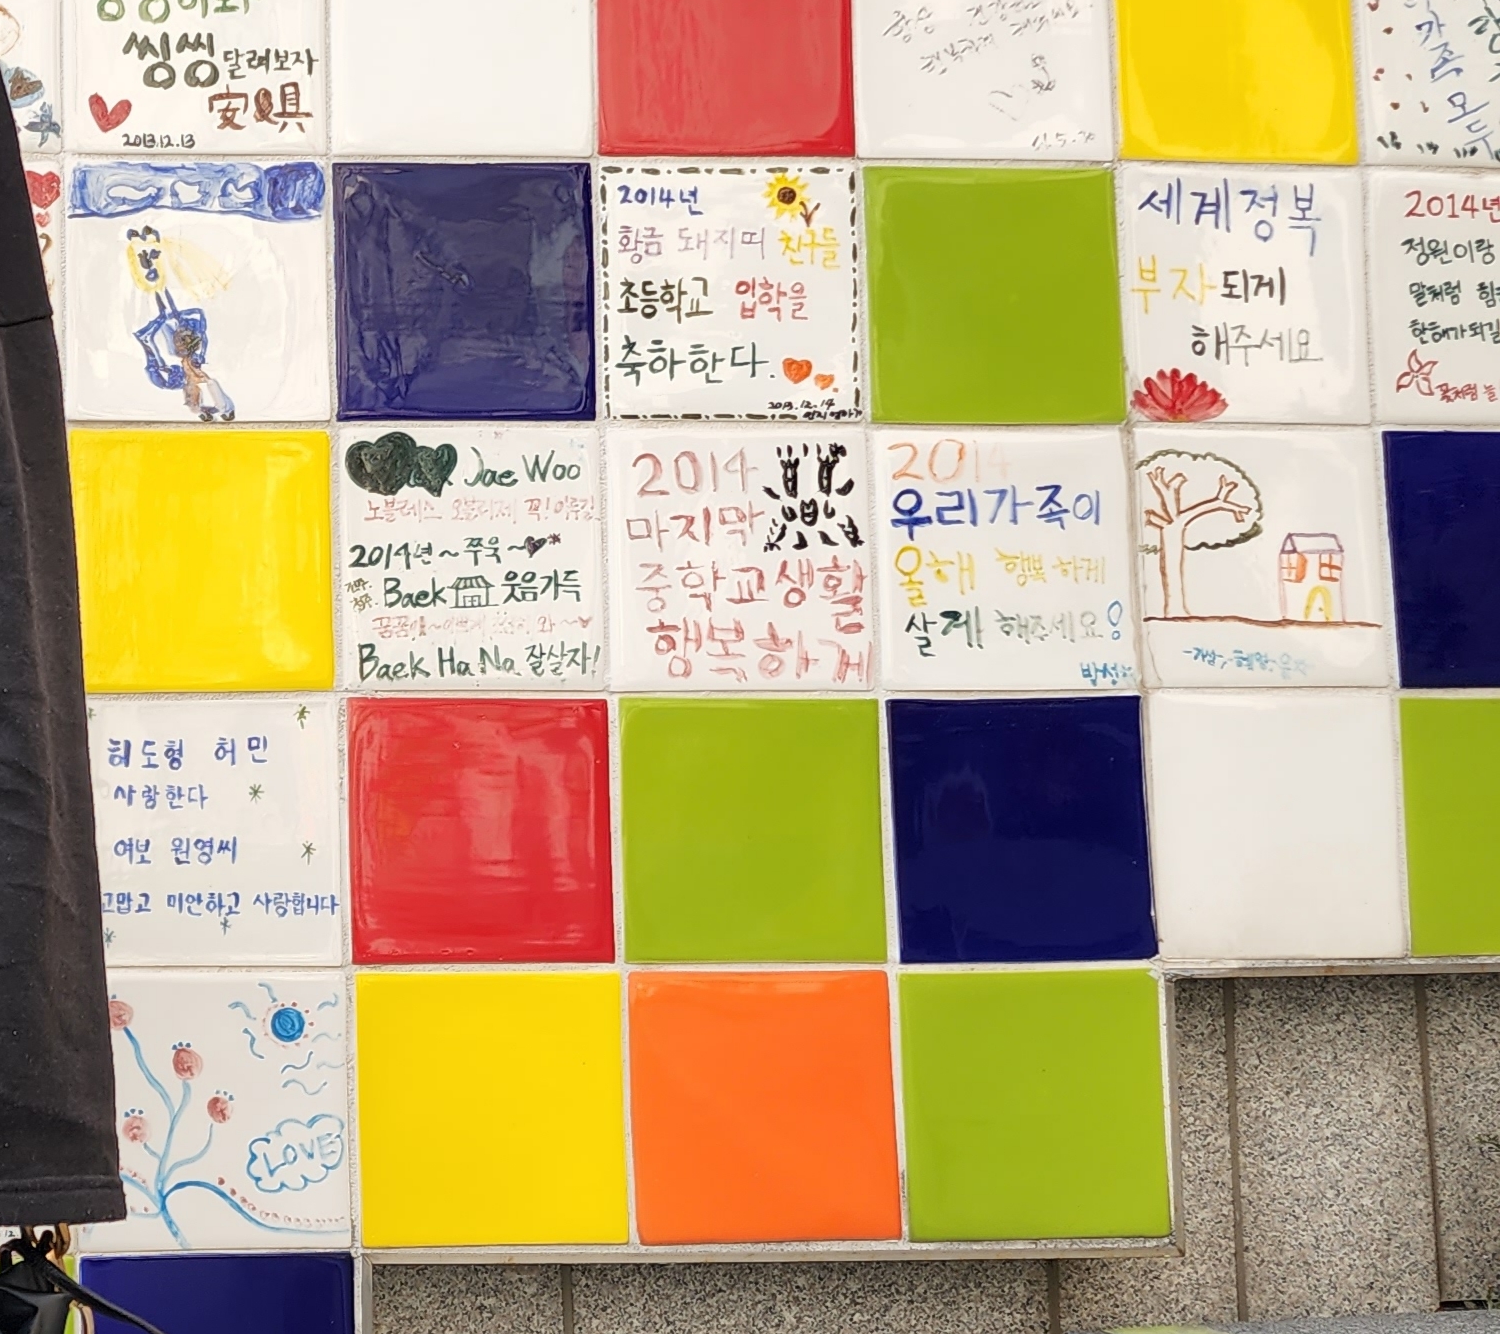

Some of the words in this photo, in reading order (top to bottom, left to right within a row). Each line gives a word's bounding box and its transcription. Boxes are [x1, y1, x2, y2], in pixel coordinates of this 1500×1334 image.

[123, 31, 220, 90] 씽씽
[222, 47, 319, 80] 달려보자
[617, 185, 703, 216] 2014년
[1138, 178, 1323, 256] 세계정복
[617, 225, 664, 265] 황금
[678, 226, 766, 261] 돼지띠
[778, 226, 840, 270] 친구들
[1400, 236, 1495, 267] 정원이랑
[617, 276, 714, 325] 초등학교
[734, 276, 809, 322] 입학을
[1190, 322, 1324, 367] 해주세요
[522, 450, 581, 482] Woo
[631, 448, 758, 498] 2014
[627, 501, 766, 553] 마지막
[891, 484, 1100, 541] 우리가족이
[383, 577, 448, 609] Baek
[502, 569, 582, 604] 웃음가득
[895, 545, 975, 608] 올해
[647, 616, 874, 684] 행복하게
[905, 606, 983, 657] 살게
[358, 643, 431, 683] Baek
[438, 646, 475, 677] Ha
[479, 645, 522, 677] Na
[113, 784, 208, 810] 사랑한다
[114, 837, 152, 865] 여보
[170, 836, 238, 865] 원영씨
[167, 892, 240, 917] 미안하고
[253, 892, 340, 918] 사랑합니다
[263, 1132, 340, 1177] LOVE
